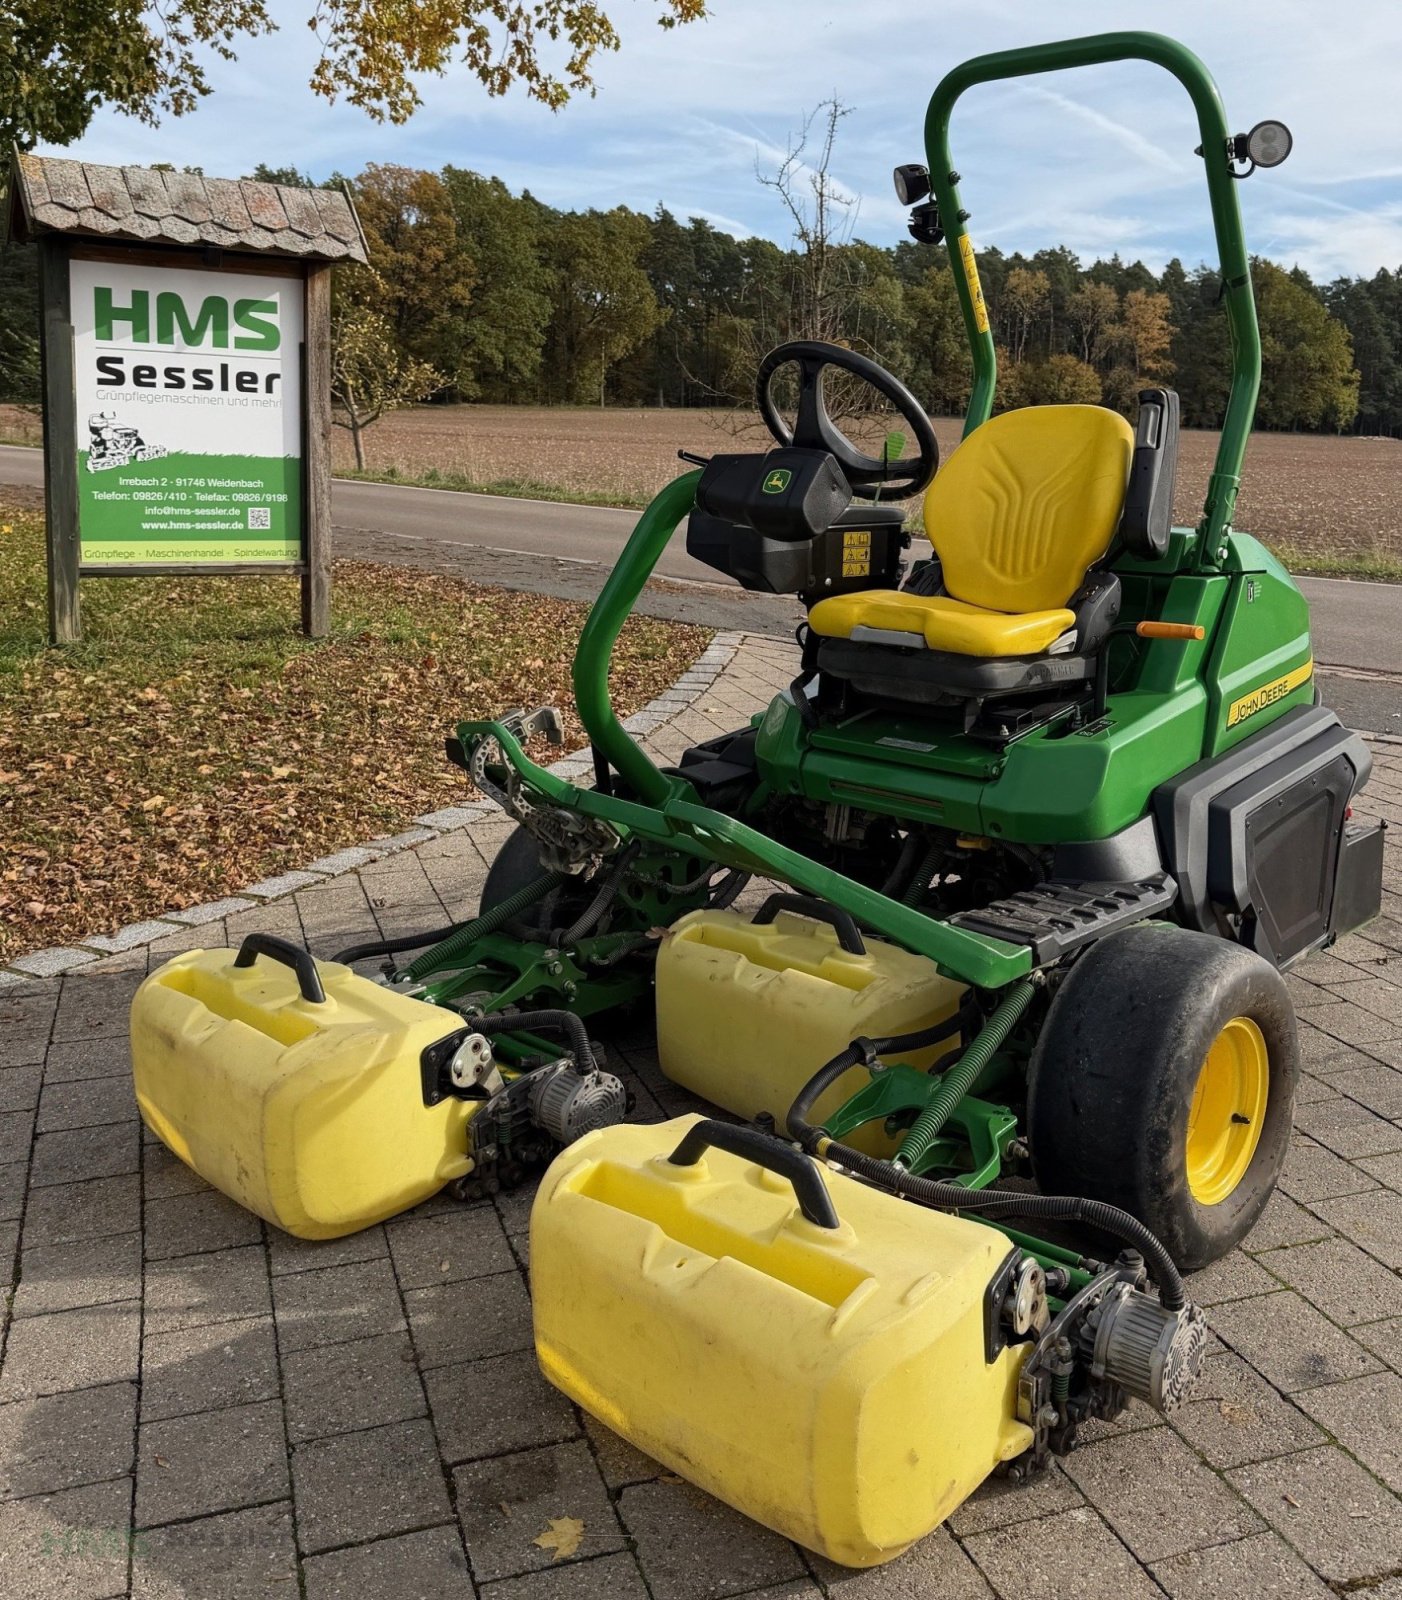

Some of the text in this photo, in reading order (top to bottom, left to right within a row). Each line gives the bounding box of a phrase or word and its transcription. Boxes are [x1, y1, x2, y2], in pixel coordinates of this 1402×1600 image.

[94, 286, 281, 351] HMS
[96, 355, 281, 394] Sessler
[96, 389, 224, 406] Grünpflegemaschinen
[228, 397, 249, 407] und
[119, 476, 159, 487] Irrebach
[161, 478, 168, 487] 2
[176, 478, 206, 487] 91746
[207, 478, 264, 488] Weidenbach
[92, 490, 131, 501] Telefon:
[133, 491, 187, 502] 09826/410
[195, 492, 230, 502] Telefax:
[232, 493, 288, 503] 09826/9198
[145, 506, 241, 517] info@hms-sessler.de
[141, 520, 244, 530] www.hms-sessler.de
[84, 548, 298, 561] Grünpflege Maschinenhandel Spindelwartung
[1234, 680, 1288, 722] JOHN DEERE
